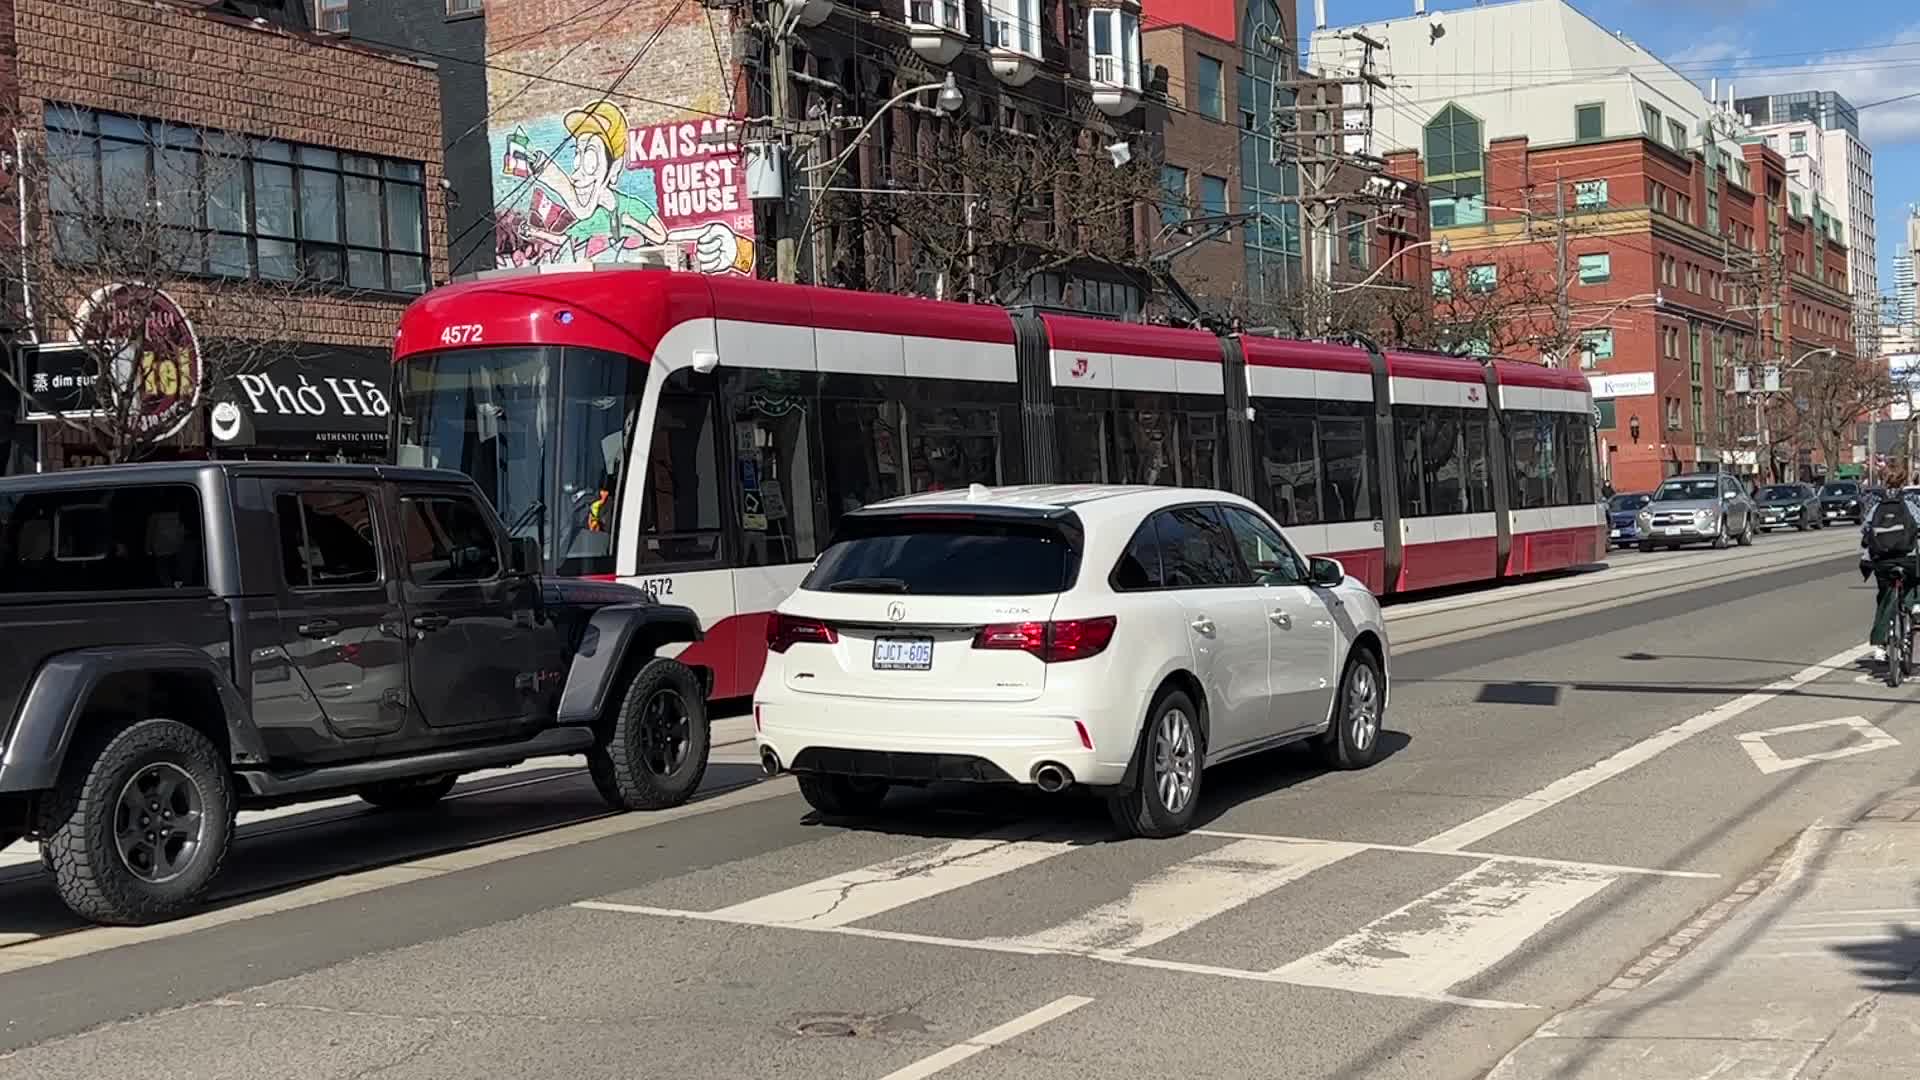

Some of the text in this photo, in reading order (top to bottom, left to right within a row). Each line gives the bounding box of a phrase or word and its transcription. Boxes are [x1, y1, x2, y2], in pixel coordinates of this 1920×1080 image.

[629, 119, 737, 161] KAISAR
[661, 160, 736, 193] GUEST
[663, 185, 738, 216] HOUSE
[441, 324, 483, 344] 4572
[52, 374, 73, 388] dim
[316, 433, 359, 441] AUTHENTIC
[641, 579, 673, 596] 4572
